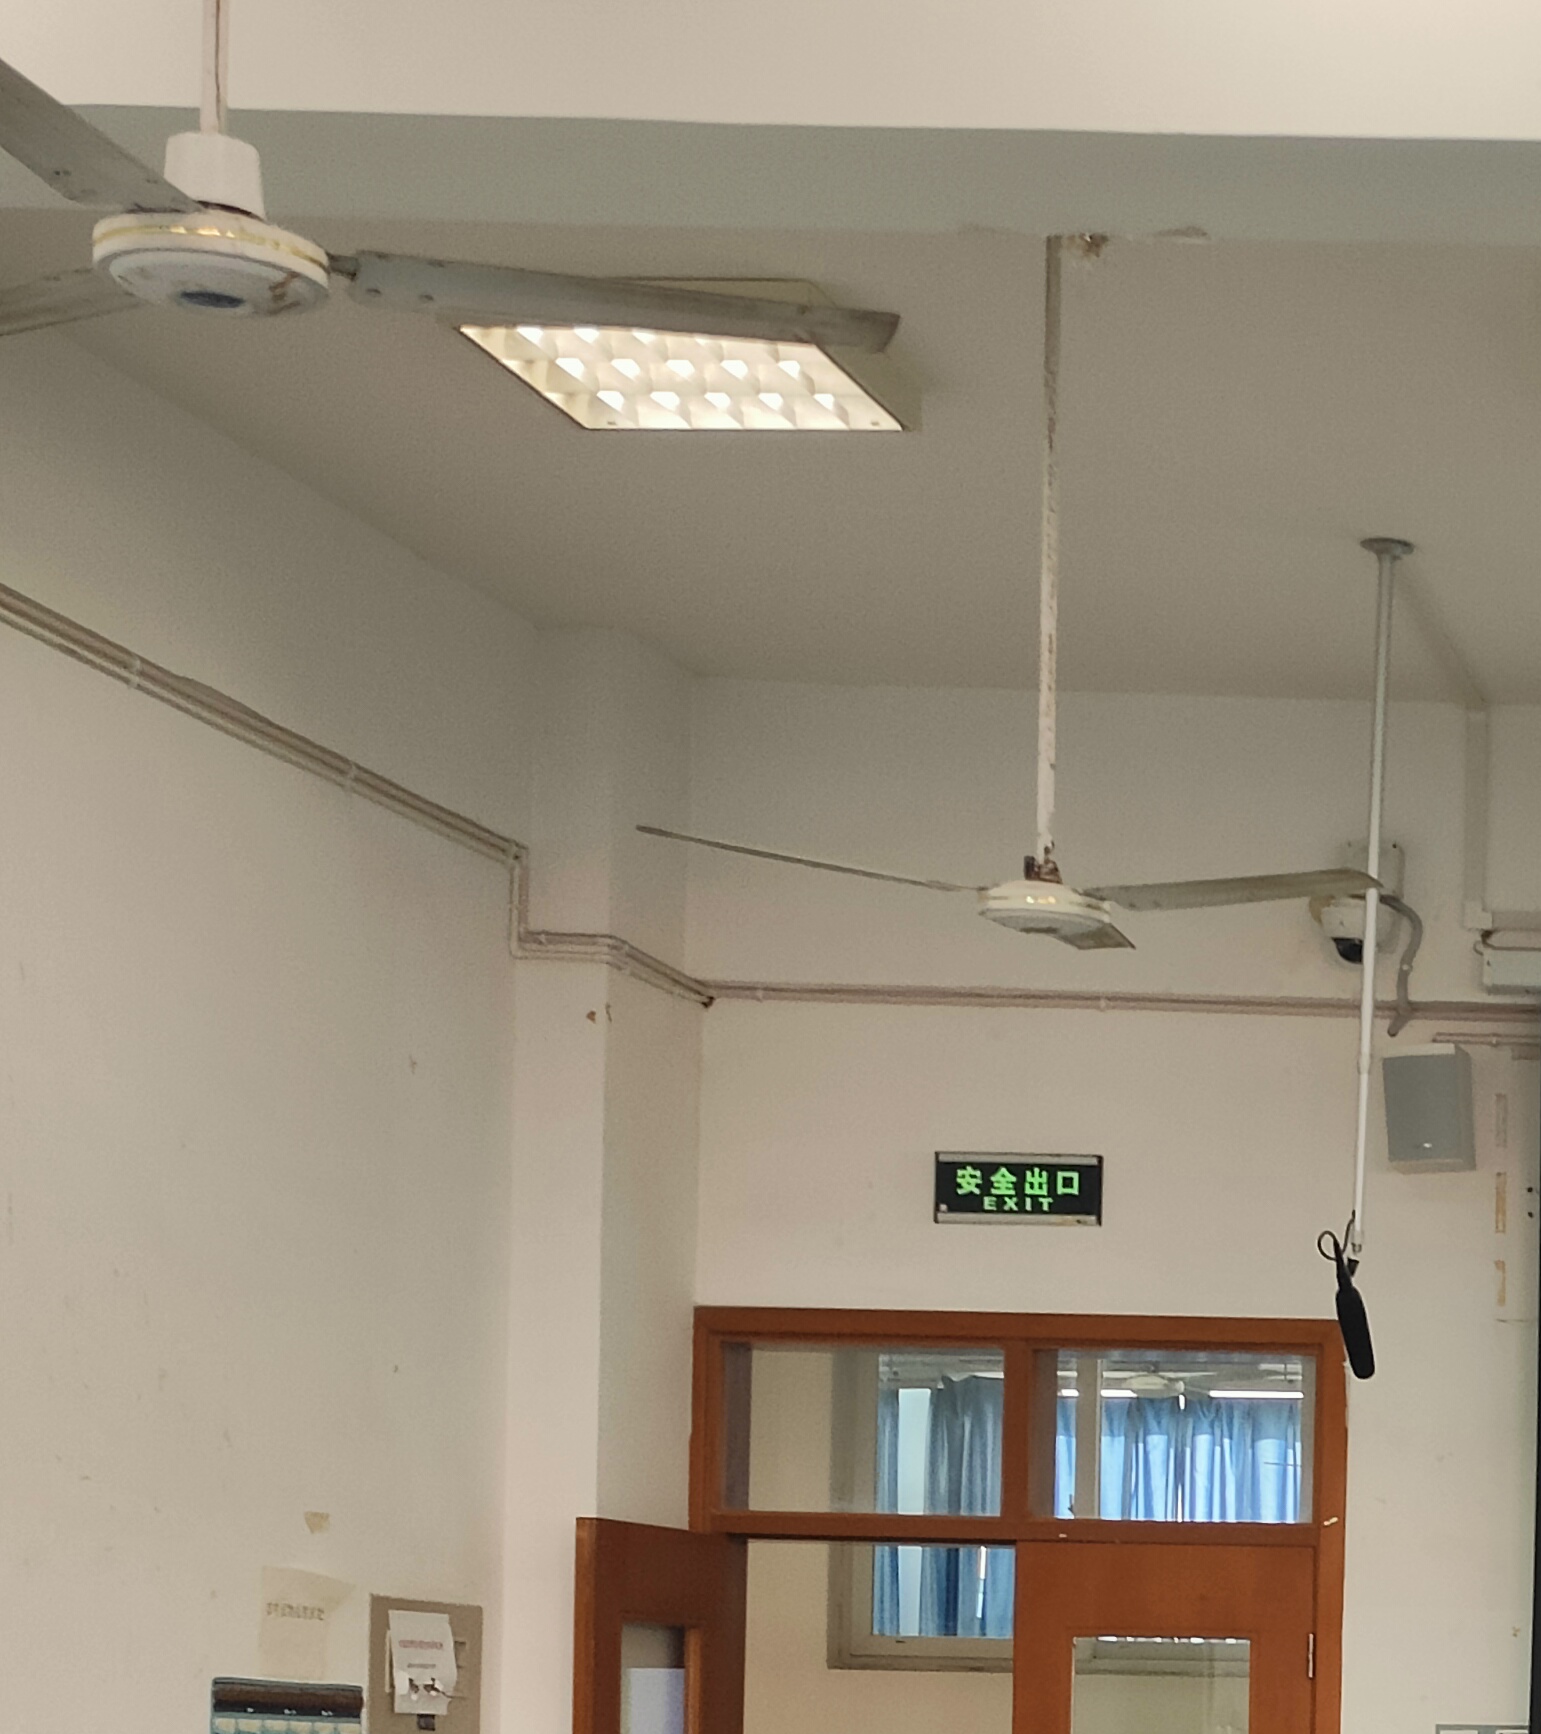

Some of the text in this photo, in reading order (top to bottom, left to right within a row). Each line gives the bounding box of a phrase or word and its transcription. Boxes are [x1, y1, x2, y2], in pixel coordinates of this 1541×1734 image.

[956, 1165, 1080, 1196] 安全出口
[983, 1196, 1054, 1212] EXIT
